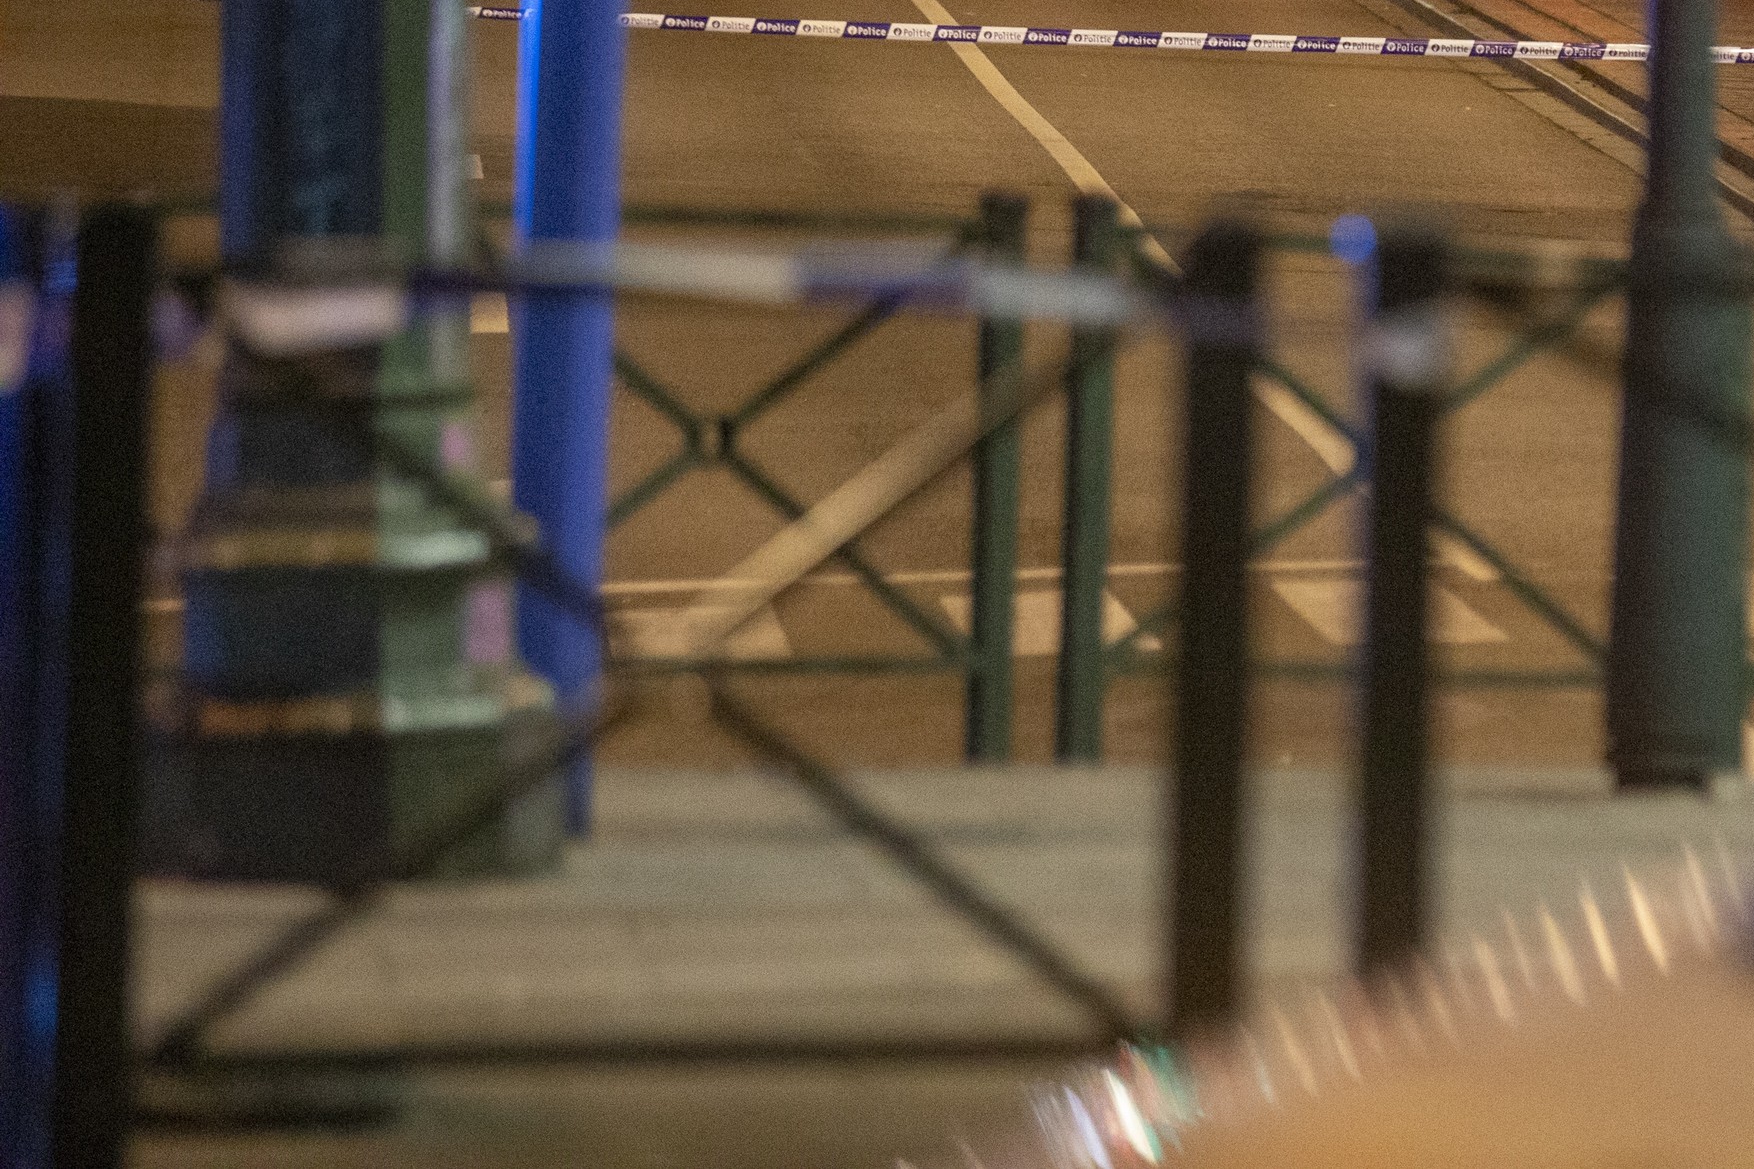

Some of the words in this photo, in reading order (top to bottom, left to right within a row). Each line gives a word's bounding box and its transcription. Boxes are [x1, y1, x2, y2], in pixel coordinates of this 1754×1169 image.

[676, 19, 705, 29] Police
[721, 20, 750, 30] Politie
[766, 22, 796, 32] Police
[811, 23, 841, 34] Politie
[857, 26, 887, 36] Police
[904, 27, 932, 37] Politie
[948, 29, 977, 39] Police
[993, 31, 1021, 41] Politie
[1038, 33, 1067, 42] Police
[1082, 34, 1111, 44] Politie
[1128, 35, 1157, 45] Police
[1173, 36, 1201, 46] Politie
[1218, 38, 1247, 47] Police
[1263, 40, 1291, 49] Politie
[1307, 40, 1336, 50] Police
[1352, 41, 1380, 51] Politie
[1396, 43, 1425, 53] Police
[1441, 44, 1469, 54] Politie
[1485, 45, 1514, 55] Police
[1529, 47, 1557, 56] Politie
[1573, 47, 1602, 57] Police
